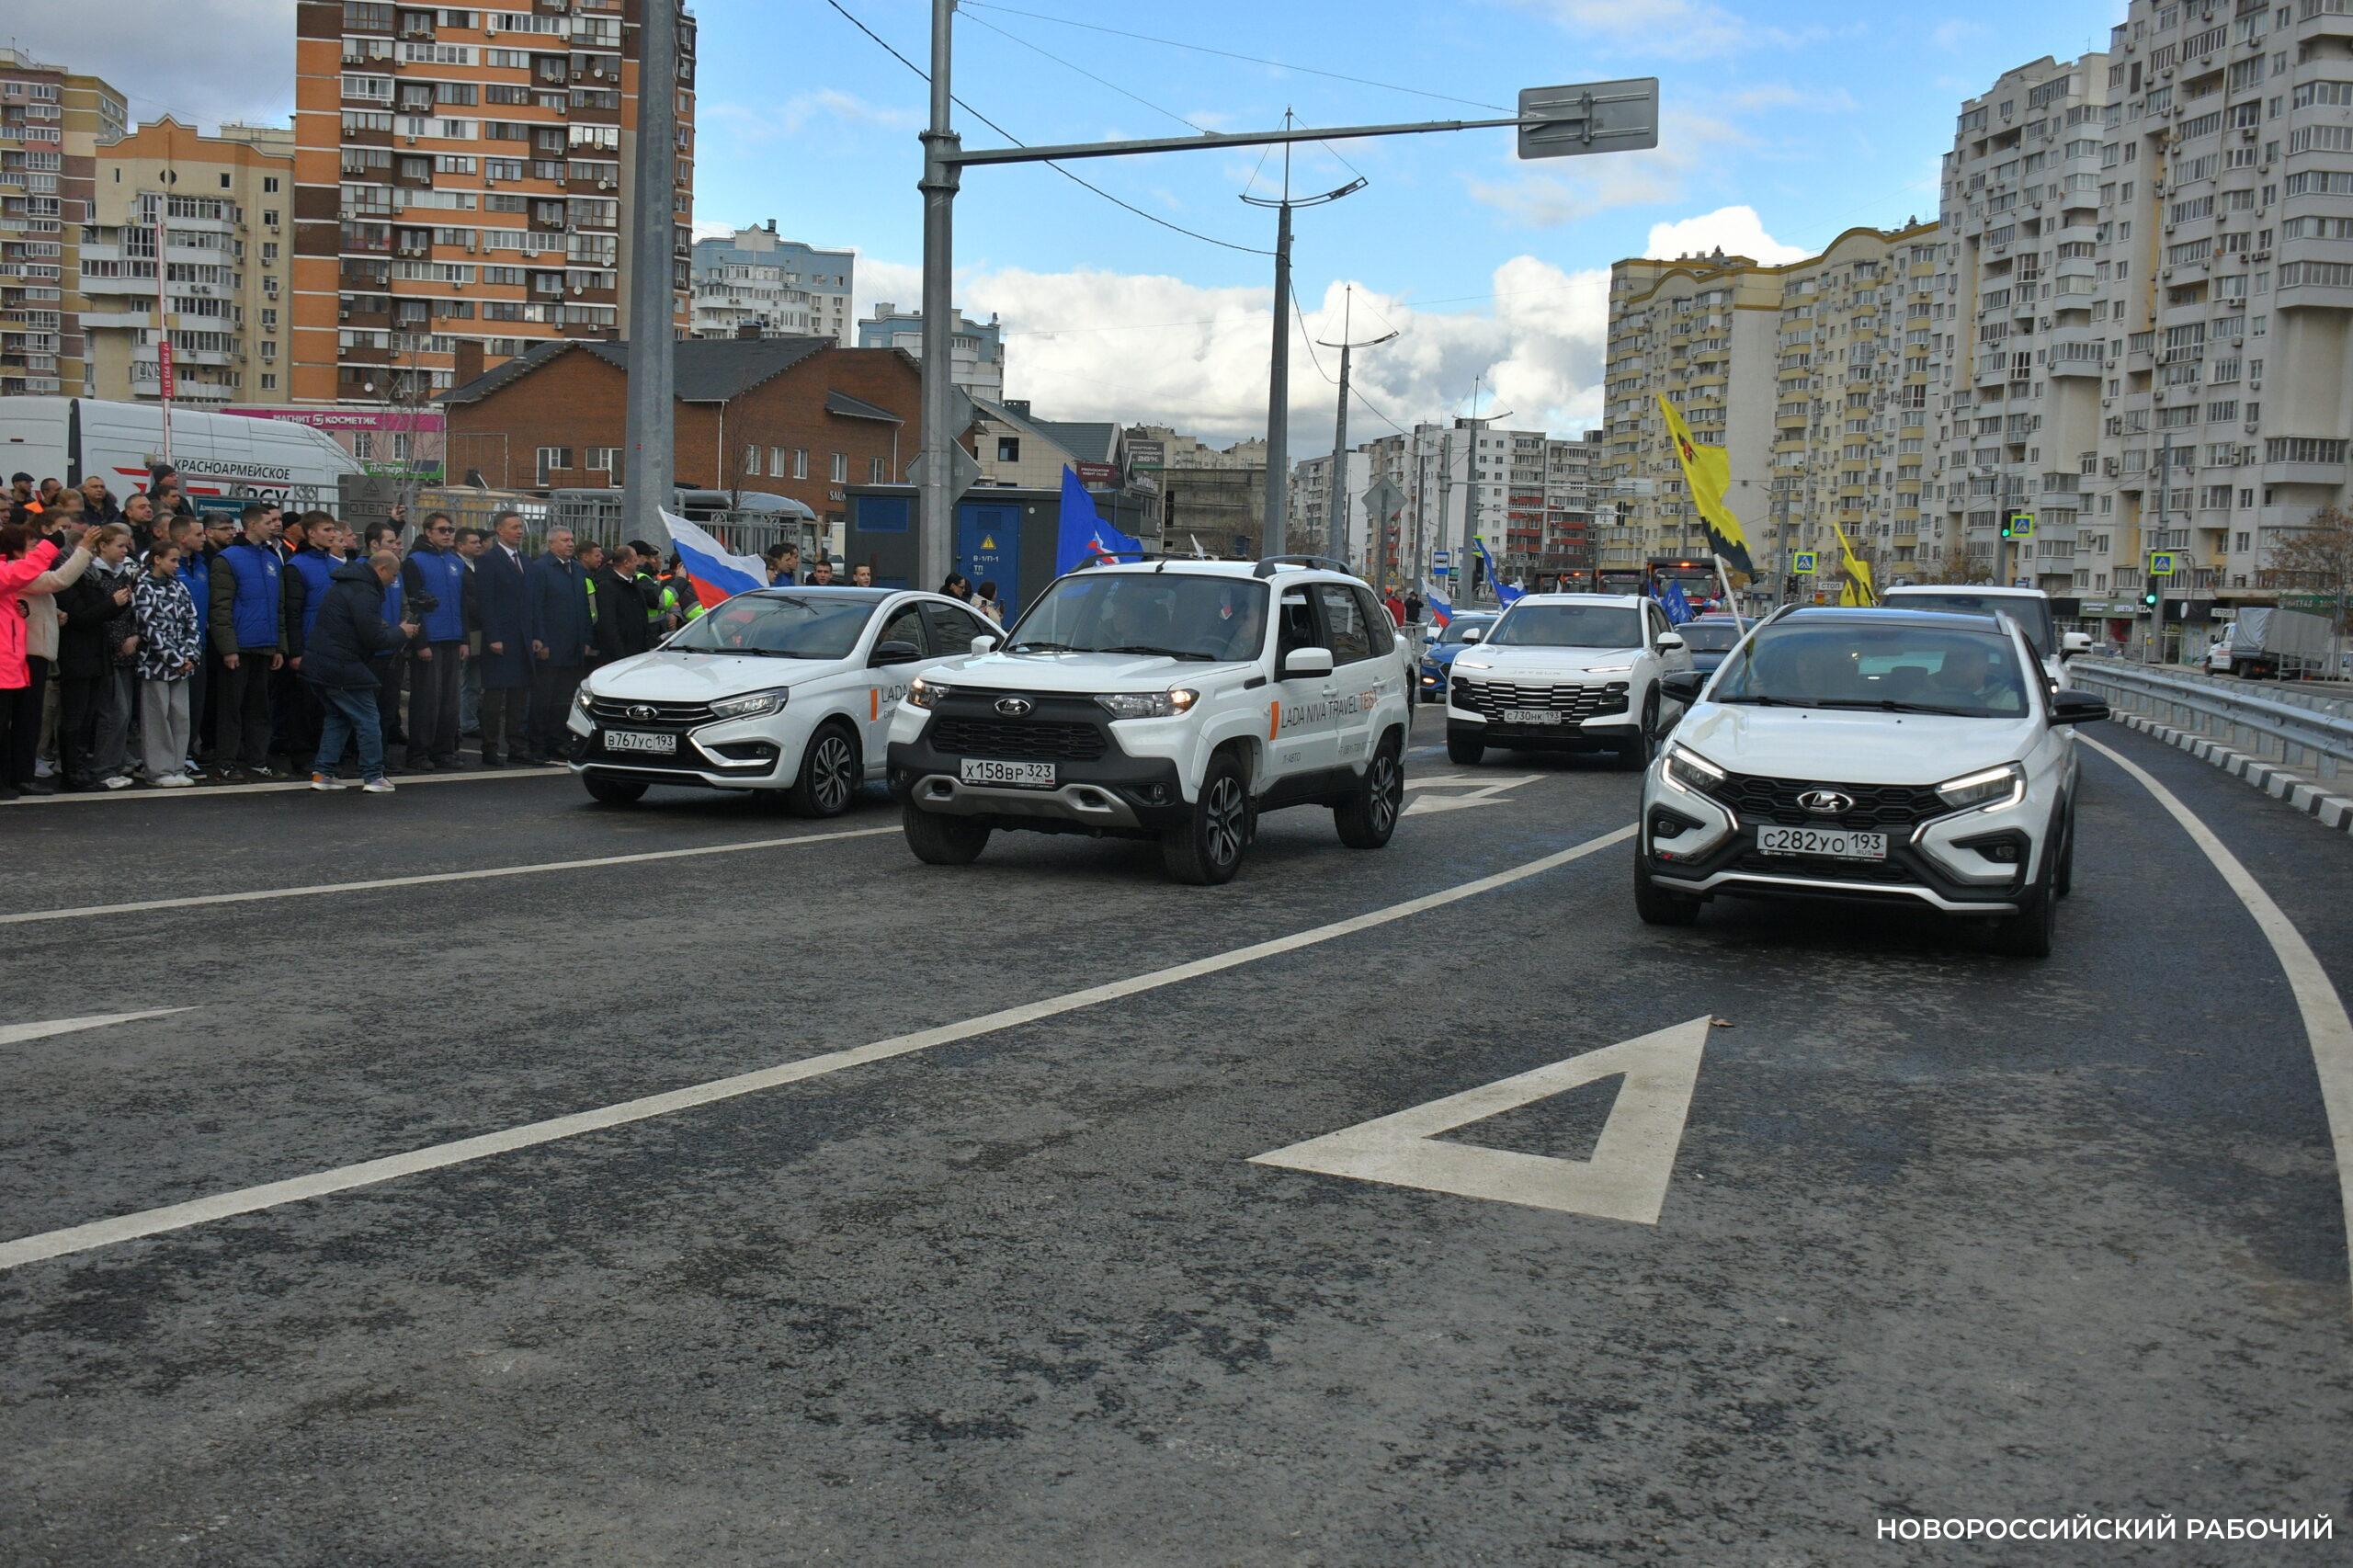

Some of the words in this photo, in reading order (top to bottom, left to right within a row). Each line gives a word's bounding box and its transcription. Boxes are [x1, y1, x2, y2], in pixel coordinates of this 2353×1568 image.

[273, 415, 311, 425] МАГНИТ
[325, 415, 377, 426] КОСМЕТИК
[174, 460, 290, 480] КРАСНОАРМЕЙСКОЕ
[1281, 706, 1304, 729] LADA
[1307, 701, 1326, 722] NIVA
[1328, 696, 1358, 718] TRAVEL
[608, 733, 653, 749] В767УС
[655, 735, 673, 746] 193
[966, 762, 1024, 781] Х158ВР
[1028, 764, 1051, 778] 323
[1764, 829, 1845, 853] С282УО
[1850, 833, 1881, 849] 193
[1856, 848, 1872, 857] RUS
